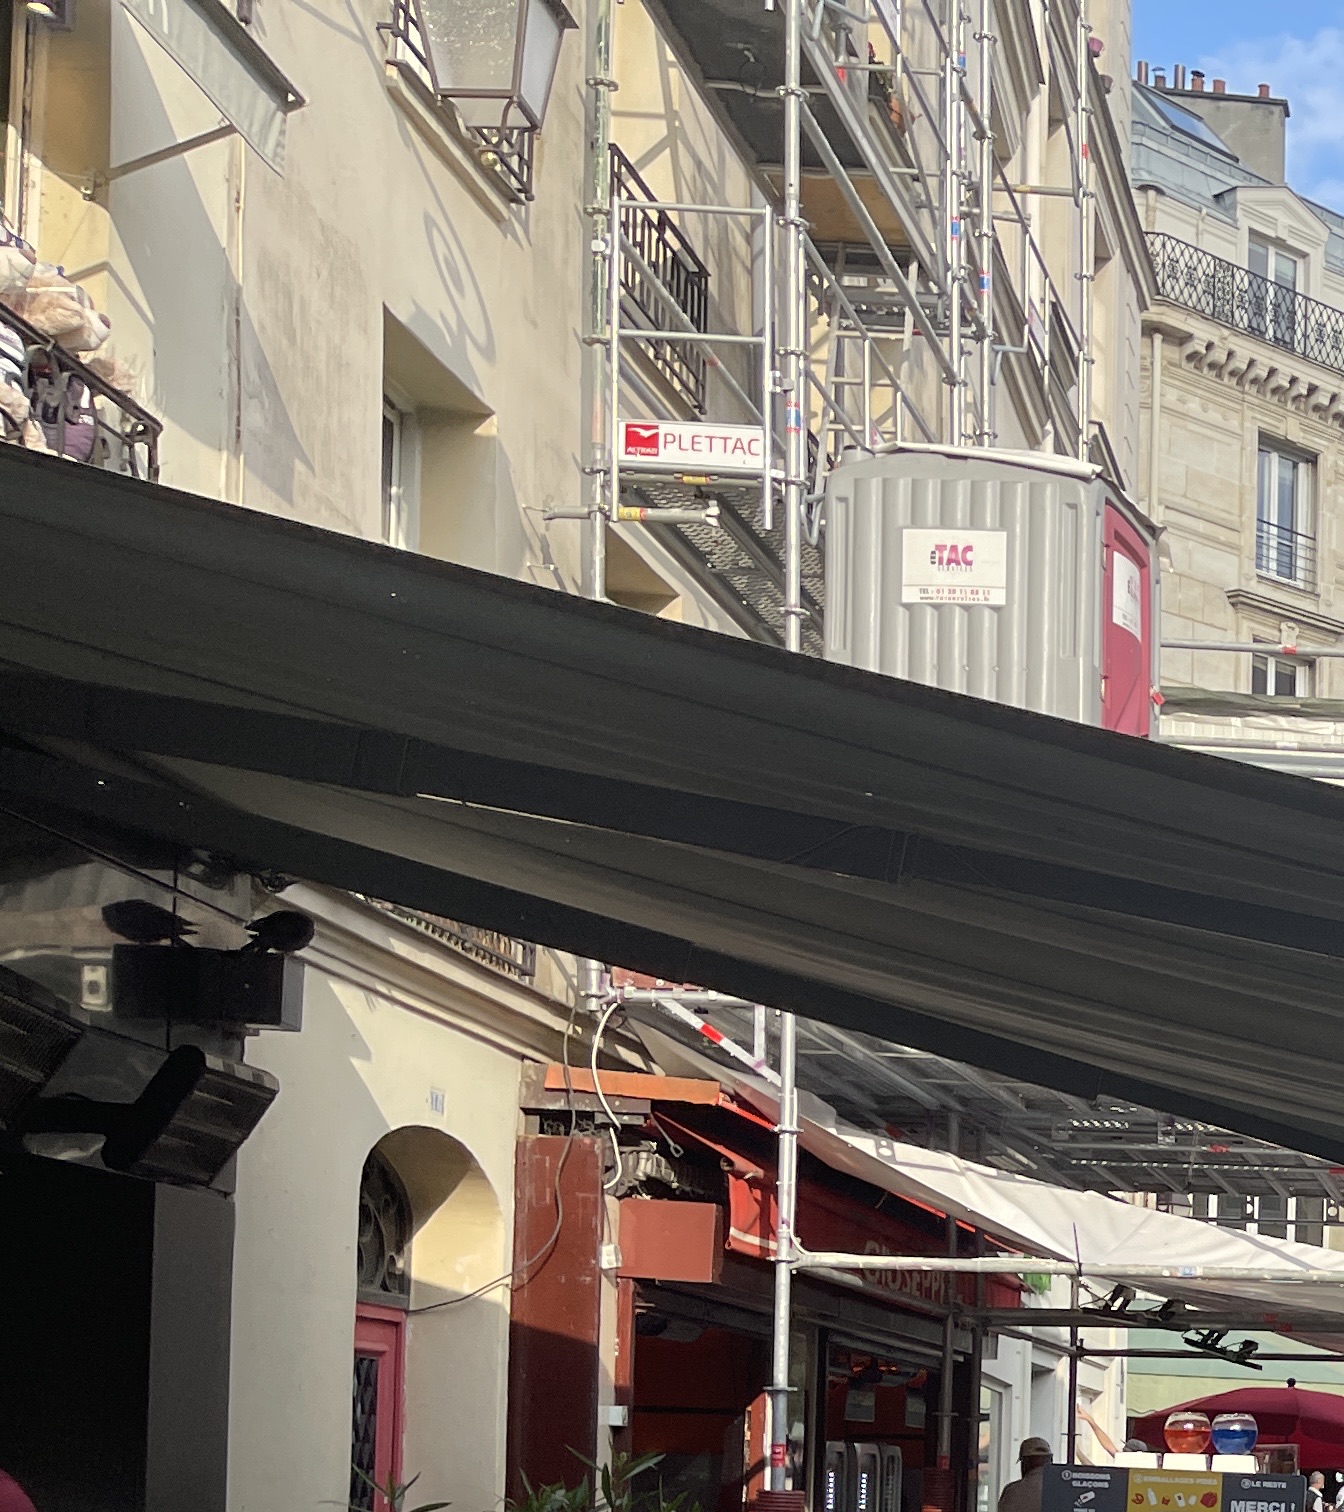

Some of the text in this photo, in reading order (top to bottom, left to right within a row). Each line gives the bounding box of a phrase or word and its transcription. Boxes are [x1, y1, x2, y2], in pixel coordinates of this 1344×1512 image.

[663, 432, 761, 456] PLETTAC
[934, 544, 974, 567] TAC
[863, 1240, 947, 1305] GIUSEPP
